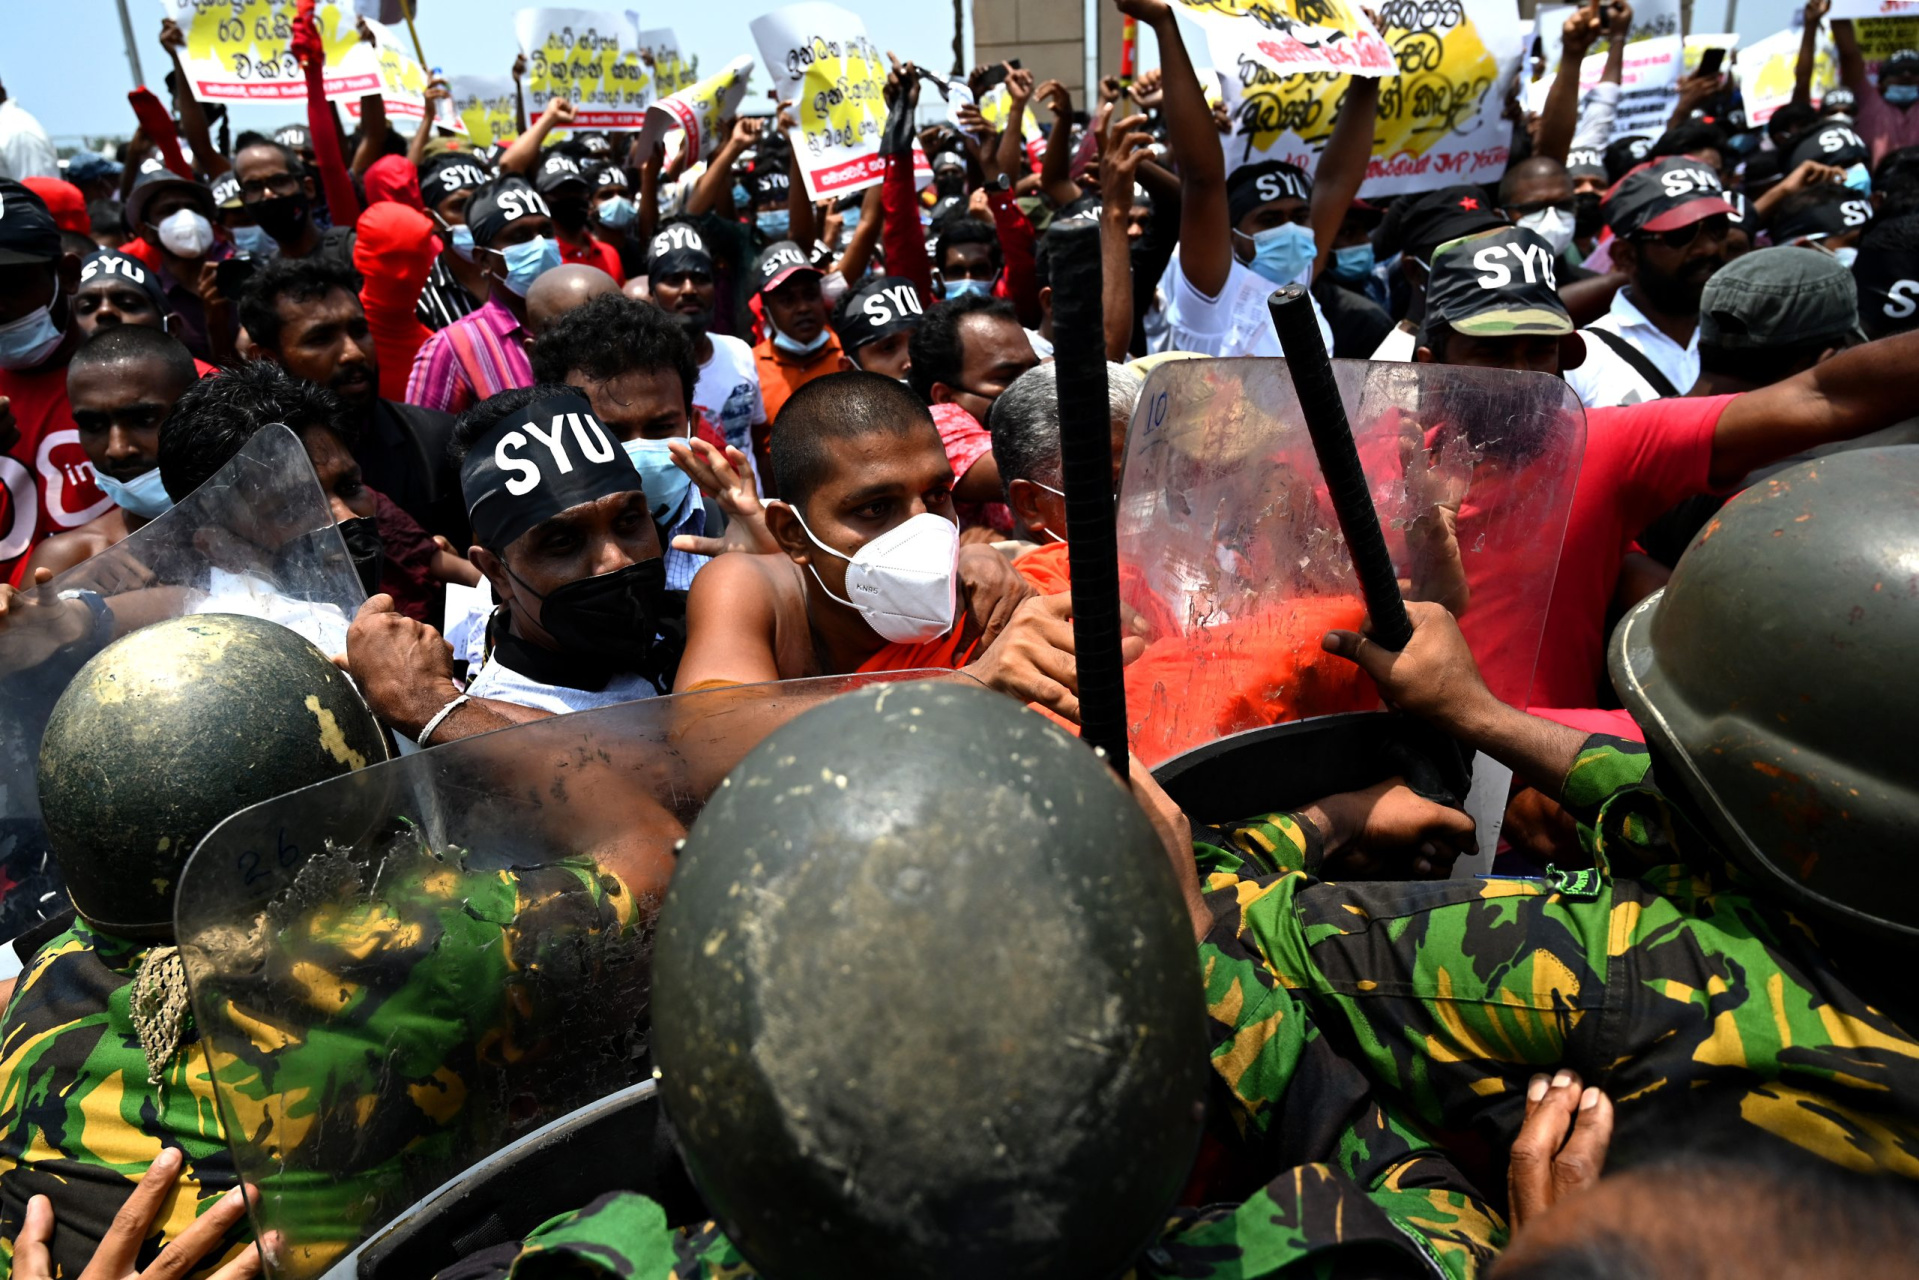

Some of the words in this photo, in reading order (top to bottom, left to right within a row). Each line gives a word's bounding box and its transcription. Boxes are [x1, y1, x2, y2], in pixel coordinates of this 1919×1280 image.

[439, 164, 486, 191] SYU
[544, 155, 580, 175] SYU
[597, 167, 629, 186] SYU
[757, 173, 790, 192] SYU
[654, 226, 703, 258] SYU
[80, 254, 145, 285] SYU
[761, 248, 805, 277] SYU
[1472, 241, 1557, 291] SYU
[862, 284, 924, 327] SYU
[1142, 390, 1168, 436] 10
[494, 412, 616, 496] SYU
[856, 583, 879, 595] KN95
[237, 826, 299, 887] 26
